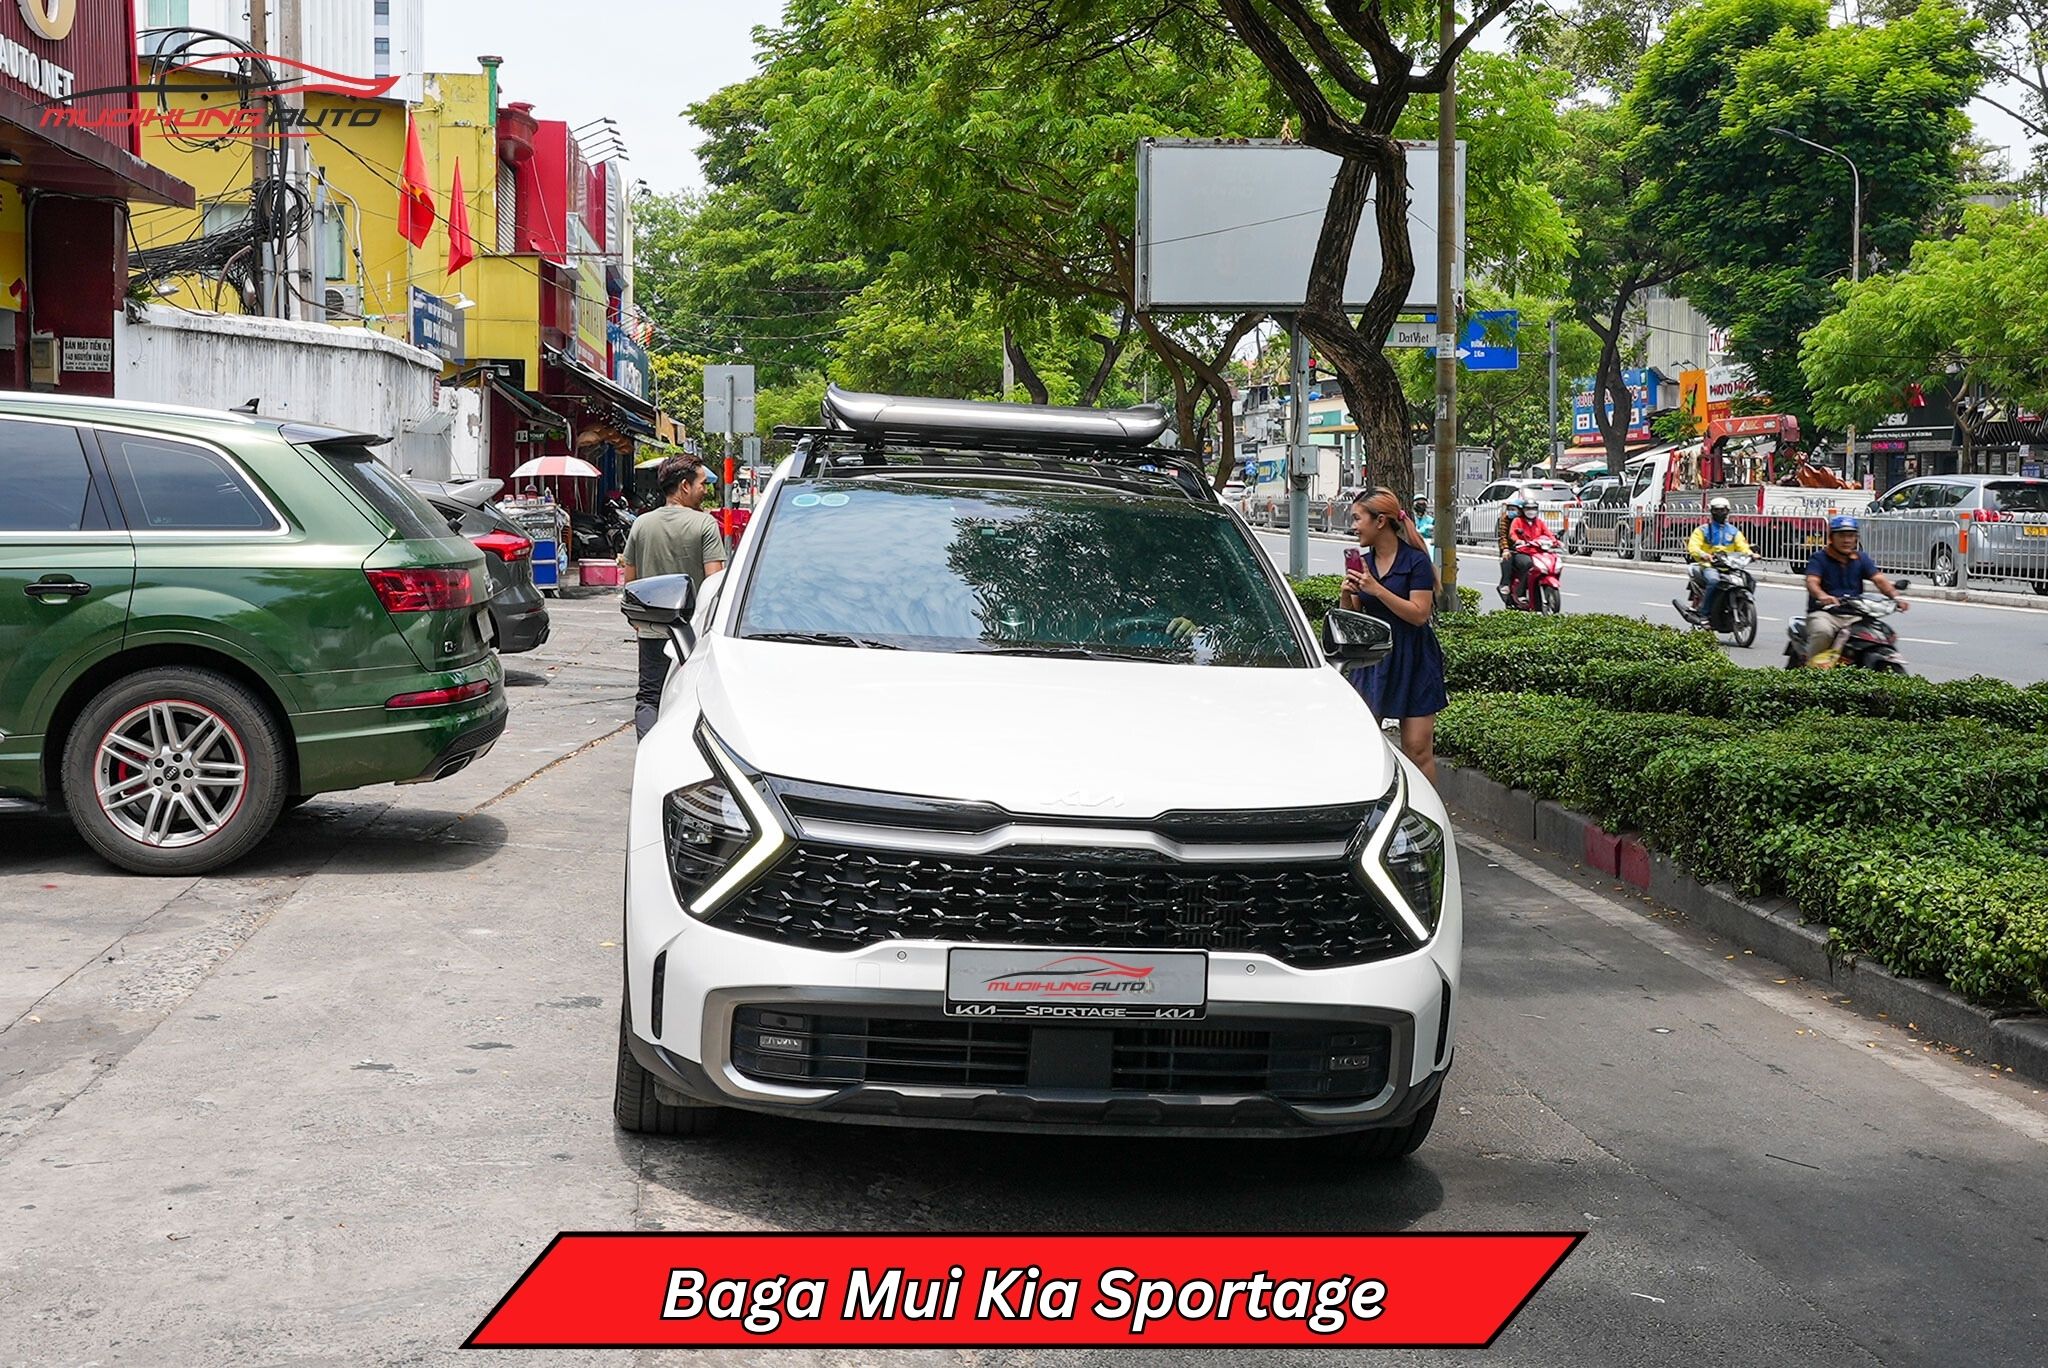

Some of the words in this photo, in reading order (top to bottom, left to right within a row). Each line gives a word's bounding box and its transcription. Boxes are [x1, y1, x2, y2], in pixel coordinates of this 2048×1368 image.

[955, 1005, 996, 1016] KIA
[1025, 1005, 1127, 1018] SPORTAGE
[1155, 1008, 1195, 1019] KIA
